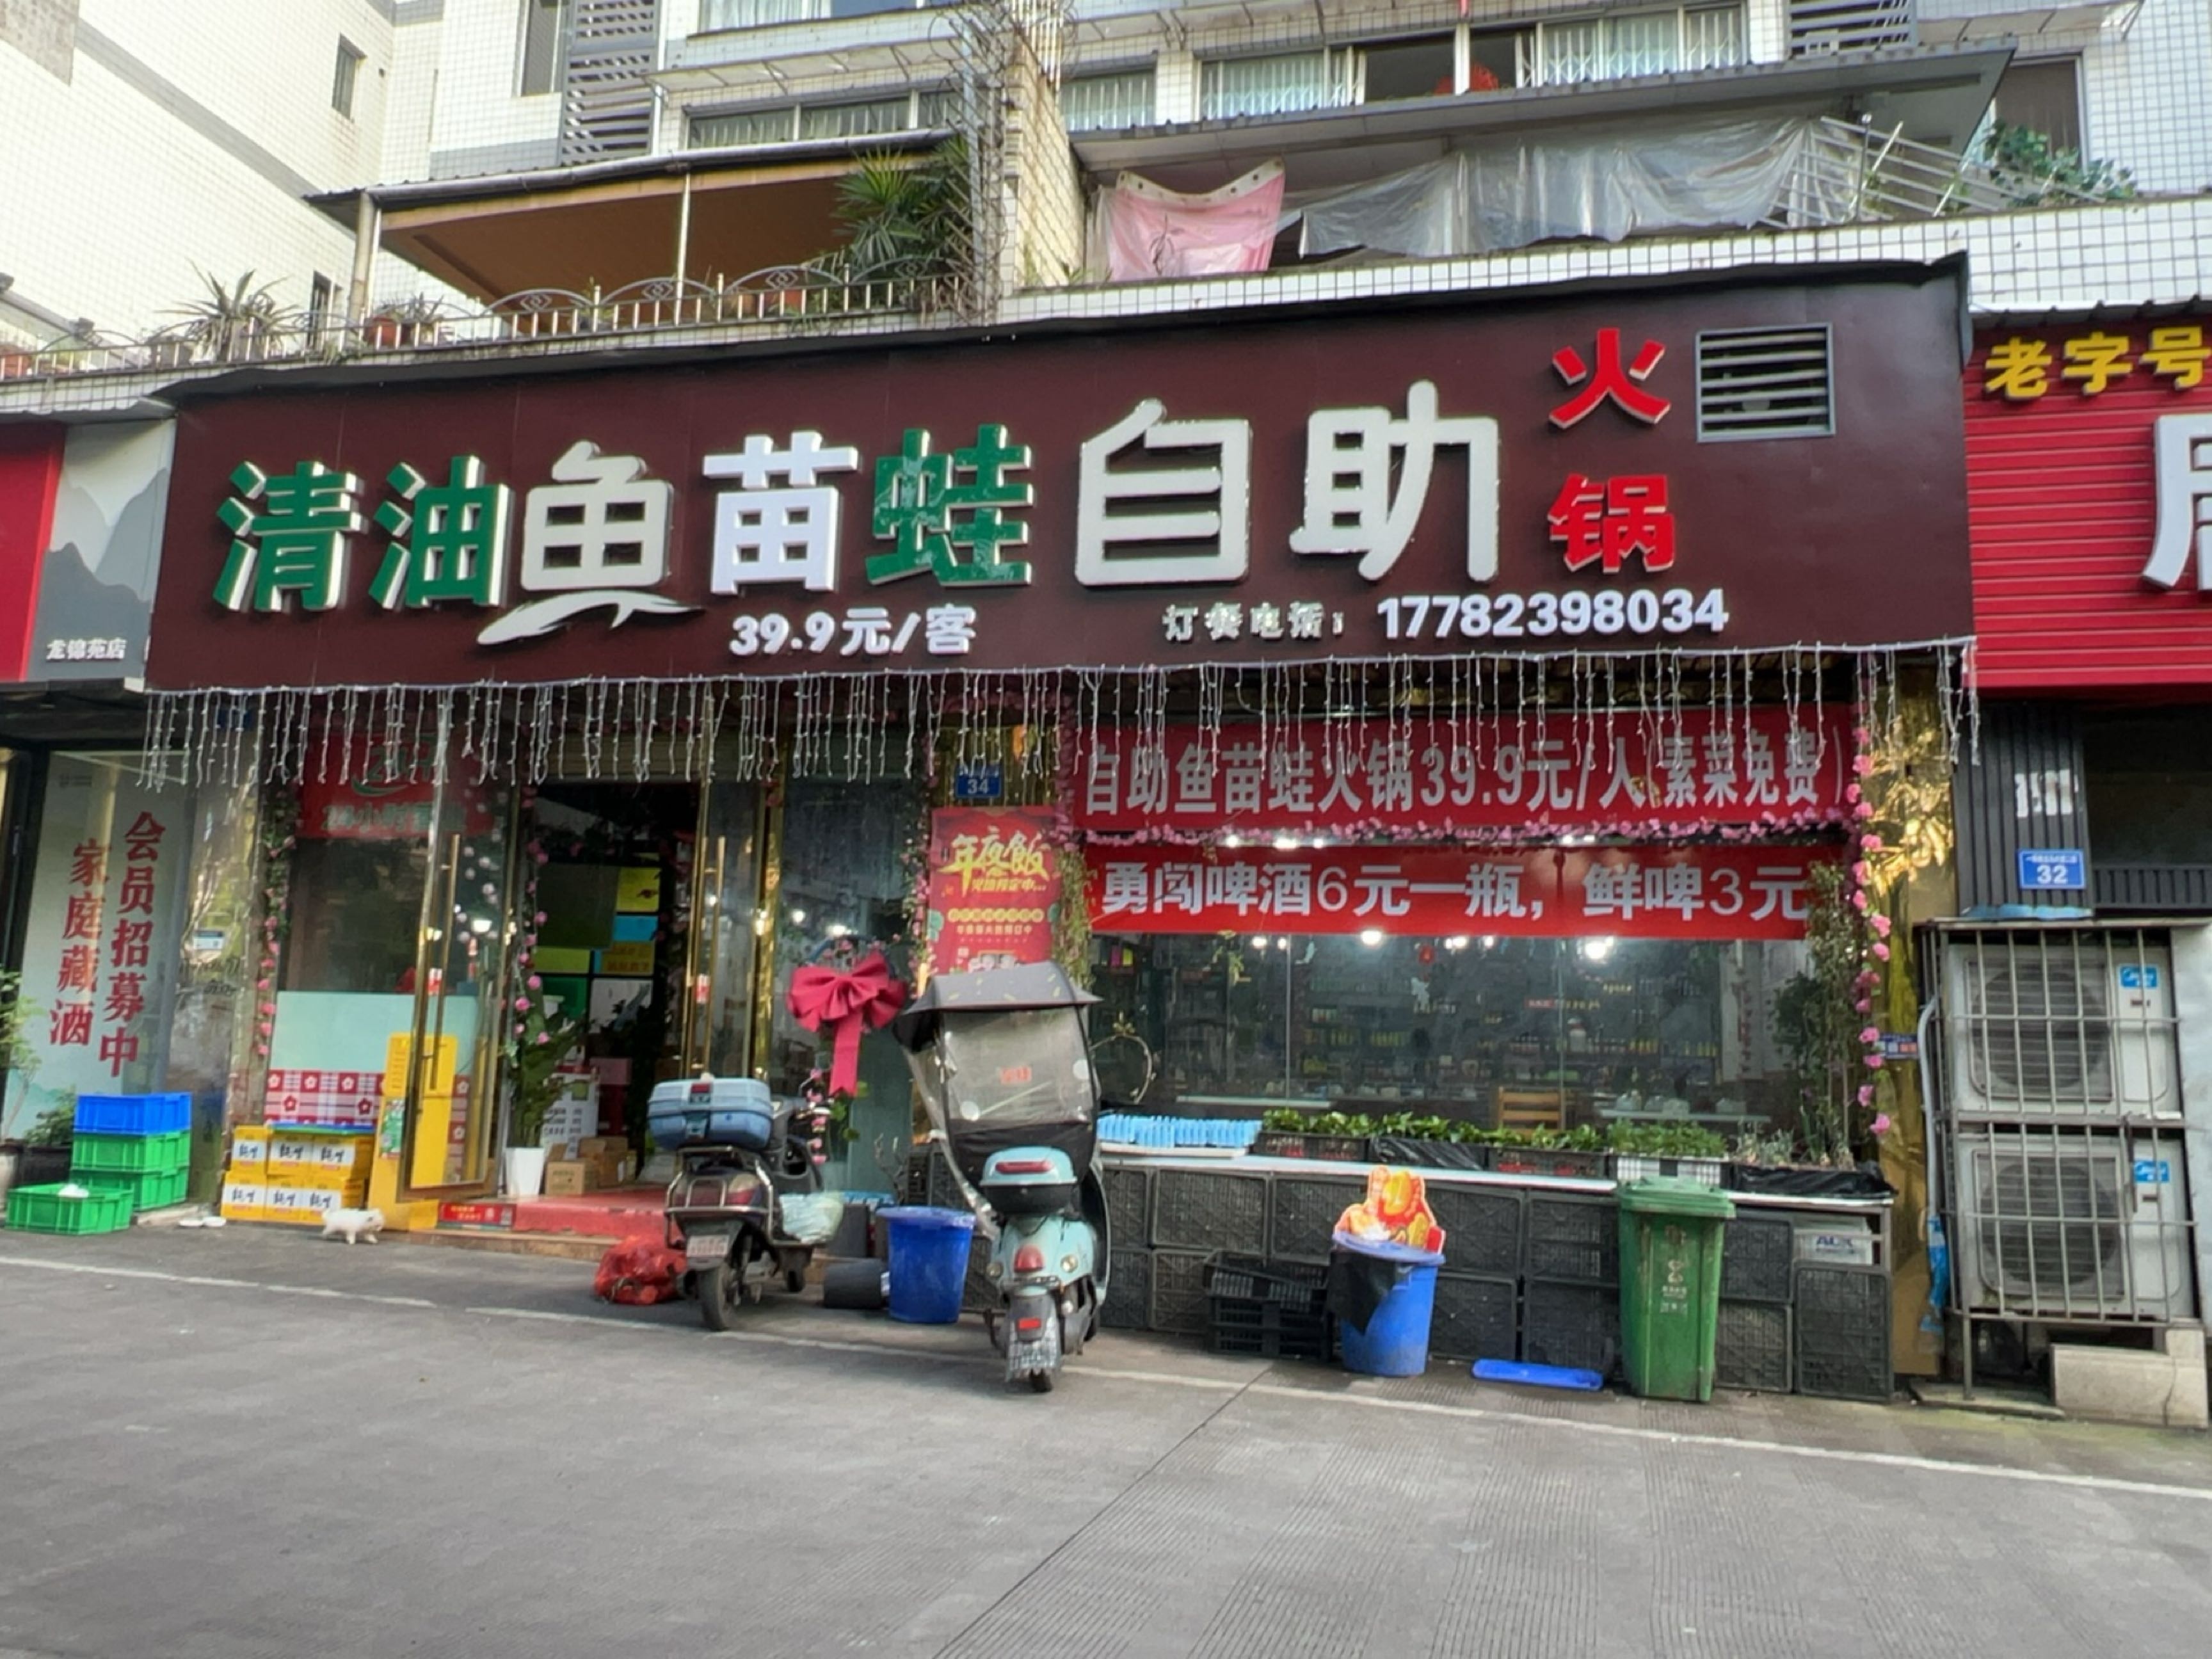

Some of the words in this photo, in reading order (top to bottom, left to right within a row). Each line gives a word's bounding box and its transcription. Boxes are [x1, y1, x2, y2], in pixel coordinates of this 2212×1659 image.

[1984, 325, 2211, 400] 老字号
[1547, 327, 1676, 573] 火锅
[729, 603, 977, 656] 39.9元/客
[1377, 589, 1729, 638] 17782398034
[966, 778, 990, 795] 34
[2036, 864, 2069, 885] 32
[49, 837, 113, 1047] 家庭藏酒
[98, 810, 167, 1078] 会员招募中
